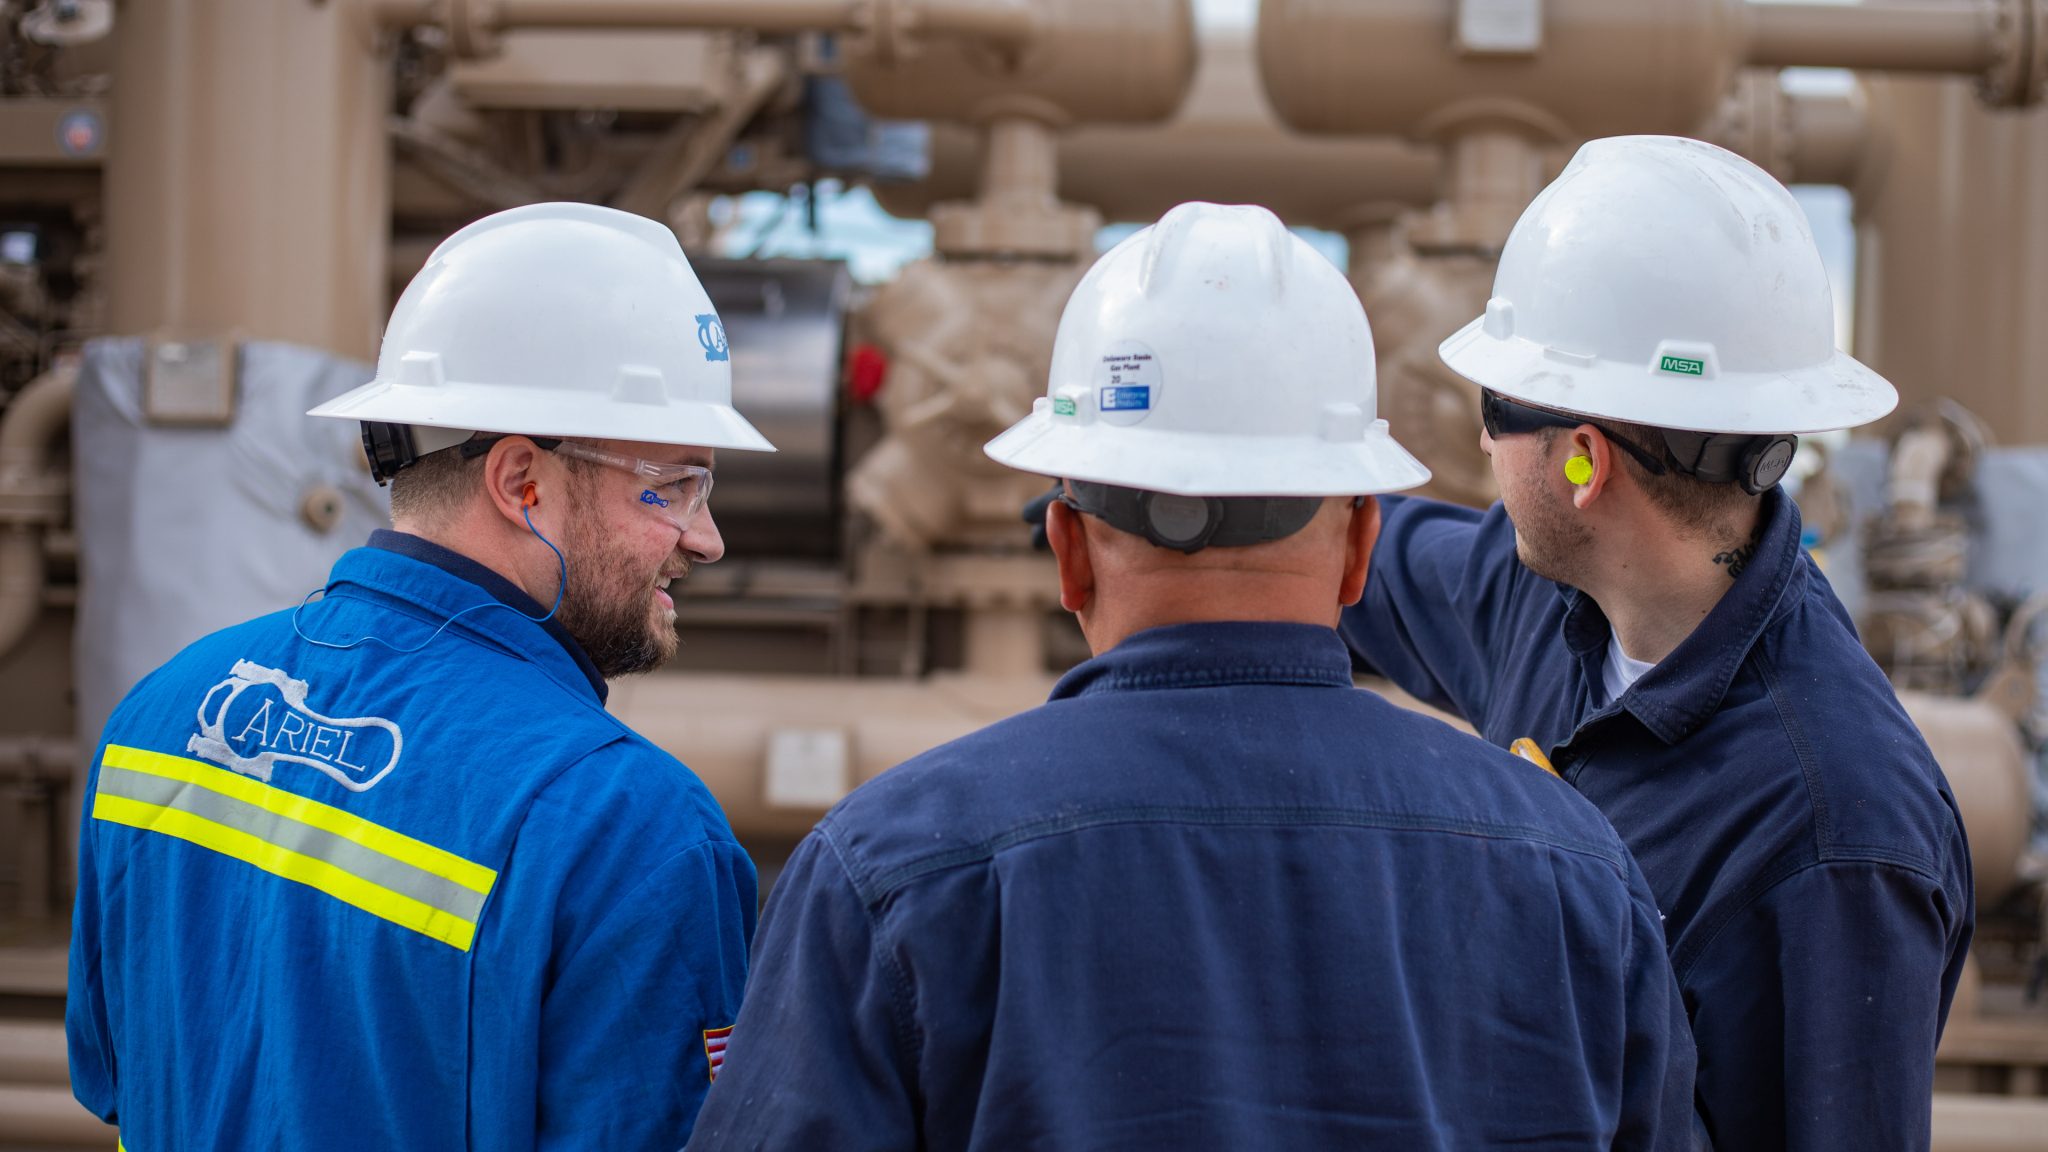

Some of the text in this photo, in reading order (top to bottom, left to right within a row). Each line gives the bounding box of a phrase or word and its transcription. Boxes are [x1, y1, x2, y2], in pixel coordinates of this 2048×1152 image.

[1122, 363, 1140, 371] Plant
[1663, 358, 1701, 373] MSA
[231, 698, 366, 772] ARIEL
